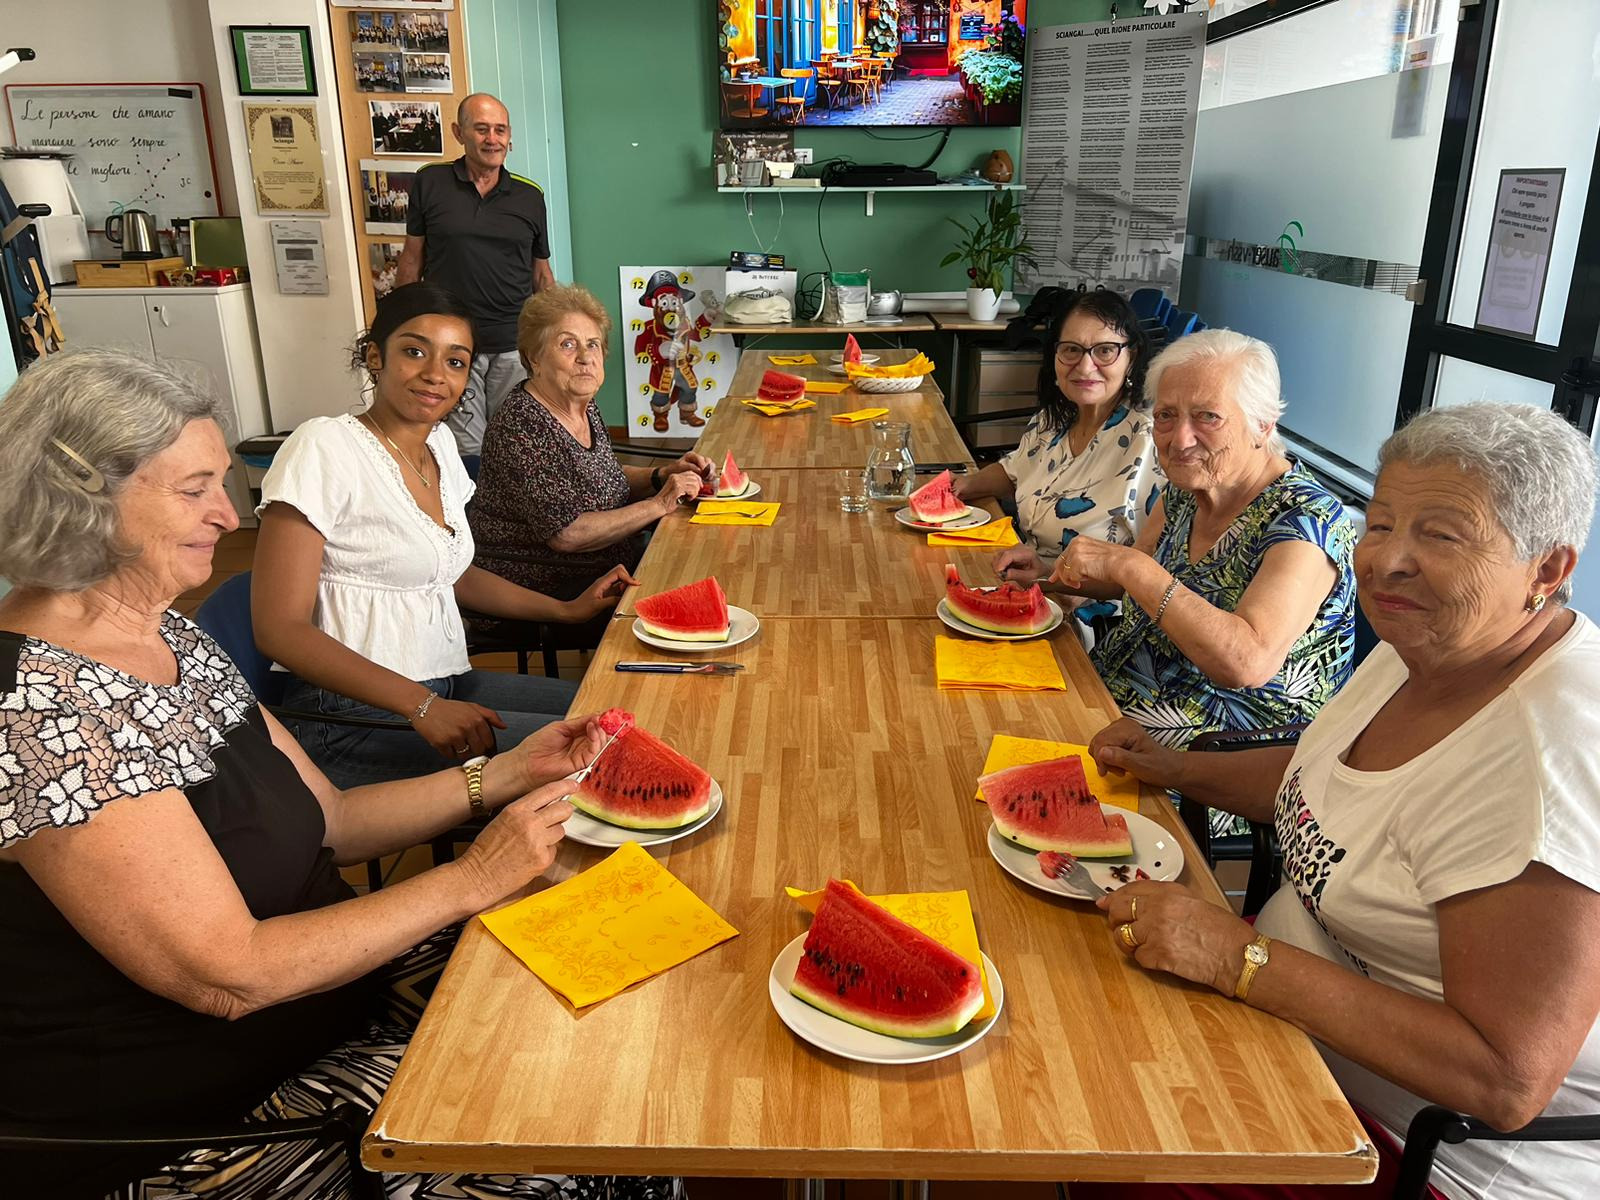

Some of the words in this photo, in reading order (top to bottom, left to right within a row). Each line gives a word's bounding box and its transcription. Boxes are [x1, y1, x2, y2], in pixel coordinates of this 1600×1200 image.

[1112, 25, 1131, 34] RIONE
[1132, 20, 1176, 32] PARTICOLARE
[20, 99, 44, 121] Le
[49, 109, 100, 130] persone
[112, 106, 130, 119] che
[138, 108, 176, 119] amano
[88, 136, 120, 148] sono
[129, 136, 168, 152] sempre
[67, 160, 79, 176] le
[682, 276, 688, 284] 2
[668, 316, 676, 325] 7
[703, 330, 712, 339] 3
[637, 356, 649, 364] 10
[709, 355, 716, 364] 4
[705, 381, 712, 390] 5
[643, 386, 650, 395] 9
[706, 409, 712, 418] 6
[641, 417, 648, 426] 8
